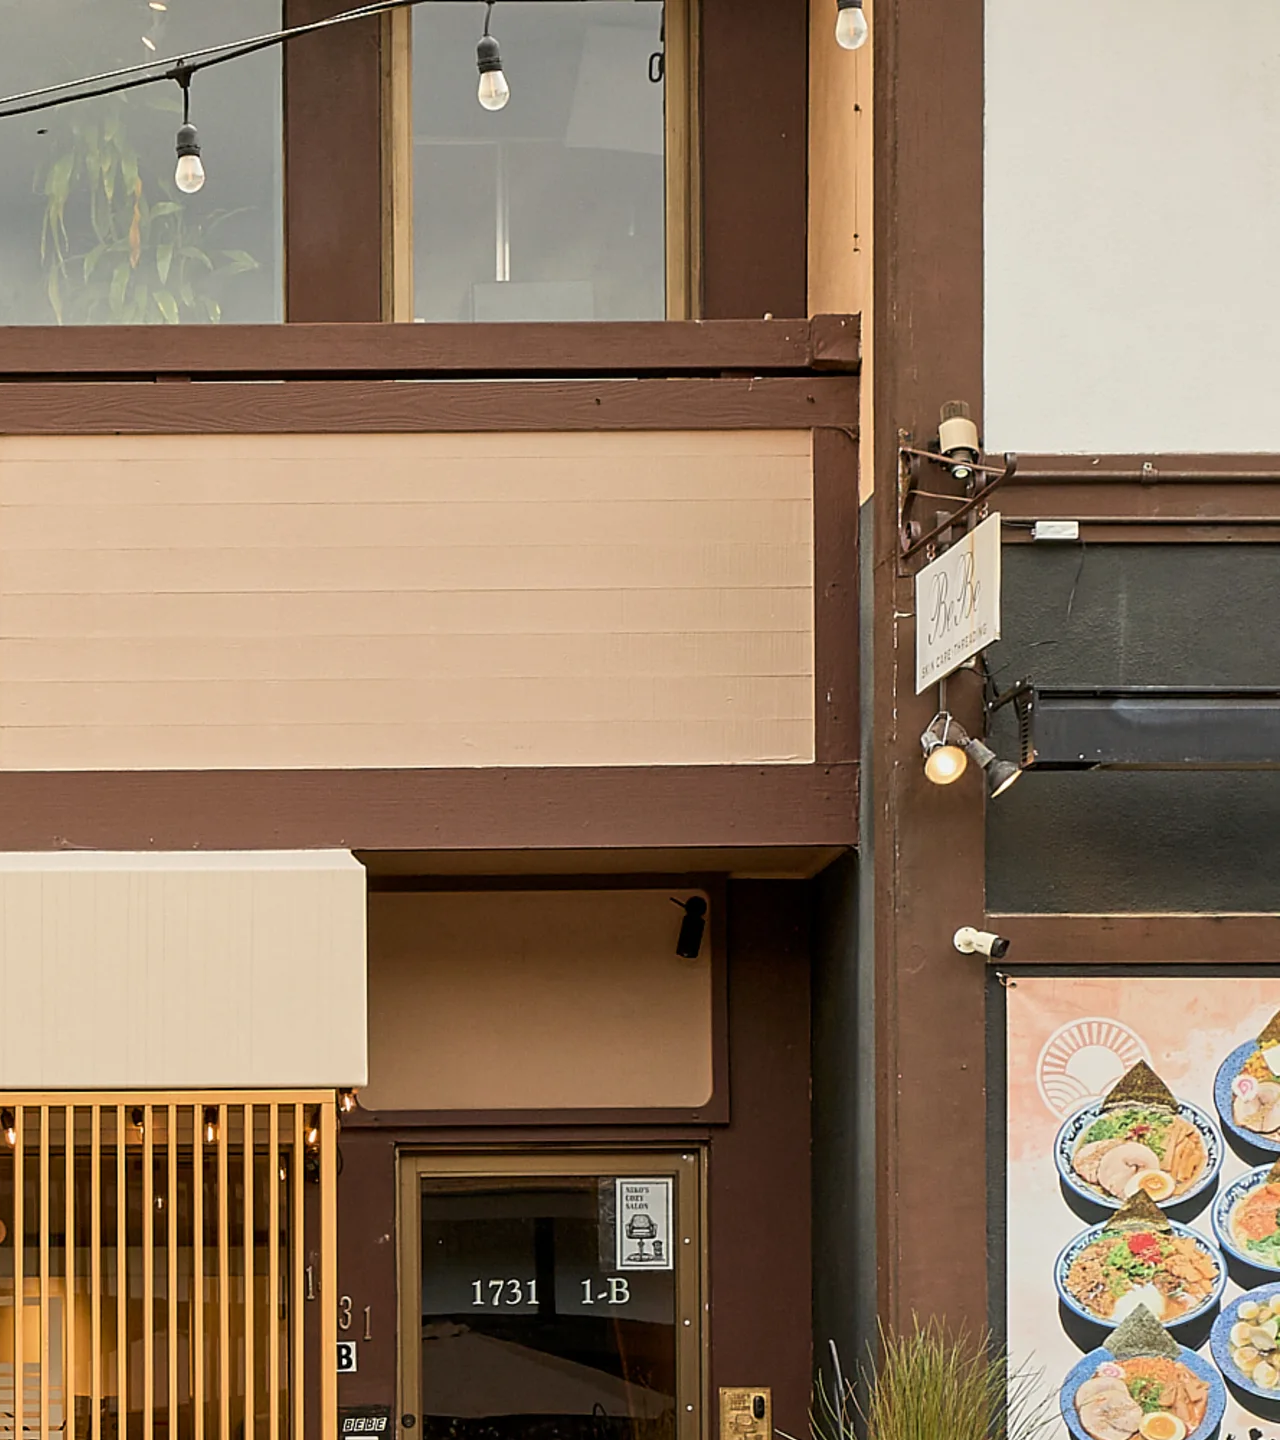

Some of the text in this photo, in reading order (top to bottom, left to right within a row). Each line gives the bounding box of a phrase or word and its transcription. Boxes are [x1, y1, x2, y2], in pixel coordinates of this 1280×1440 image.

[471, 1277, 631, 1306] 1731 1-B
[337, 1343, 354, 1371] B
[343, 1417, 387, 1432] BEBE
